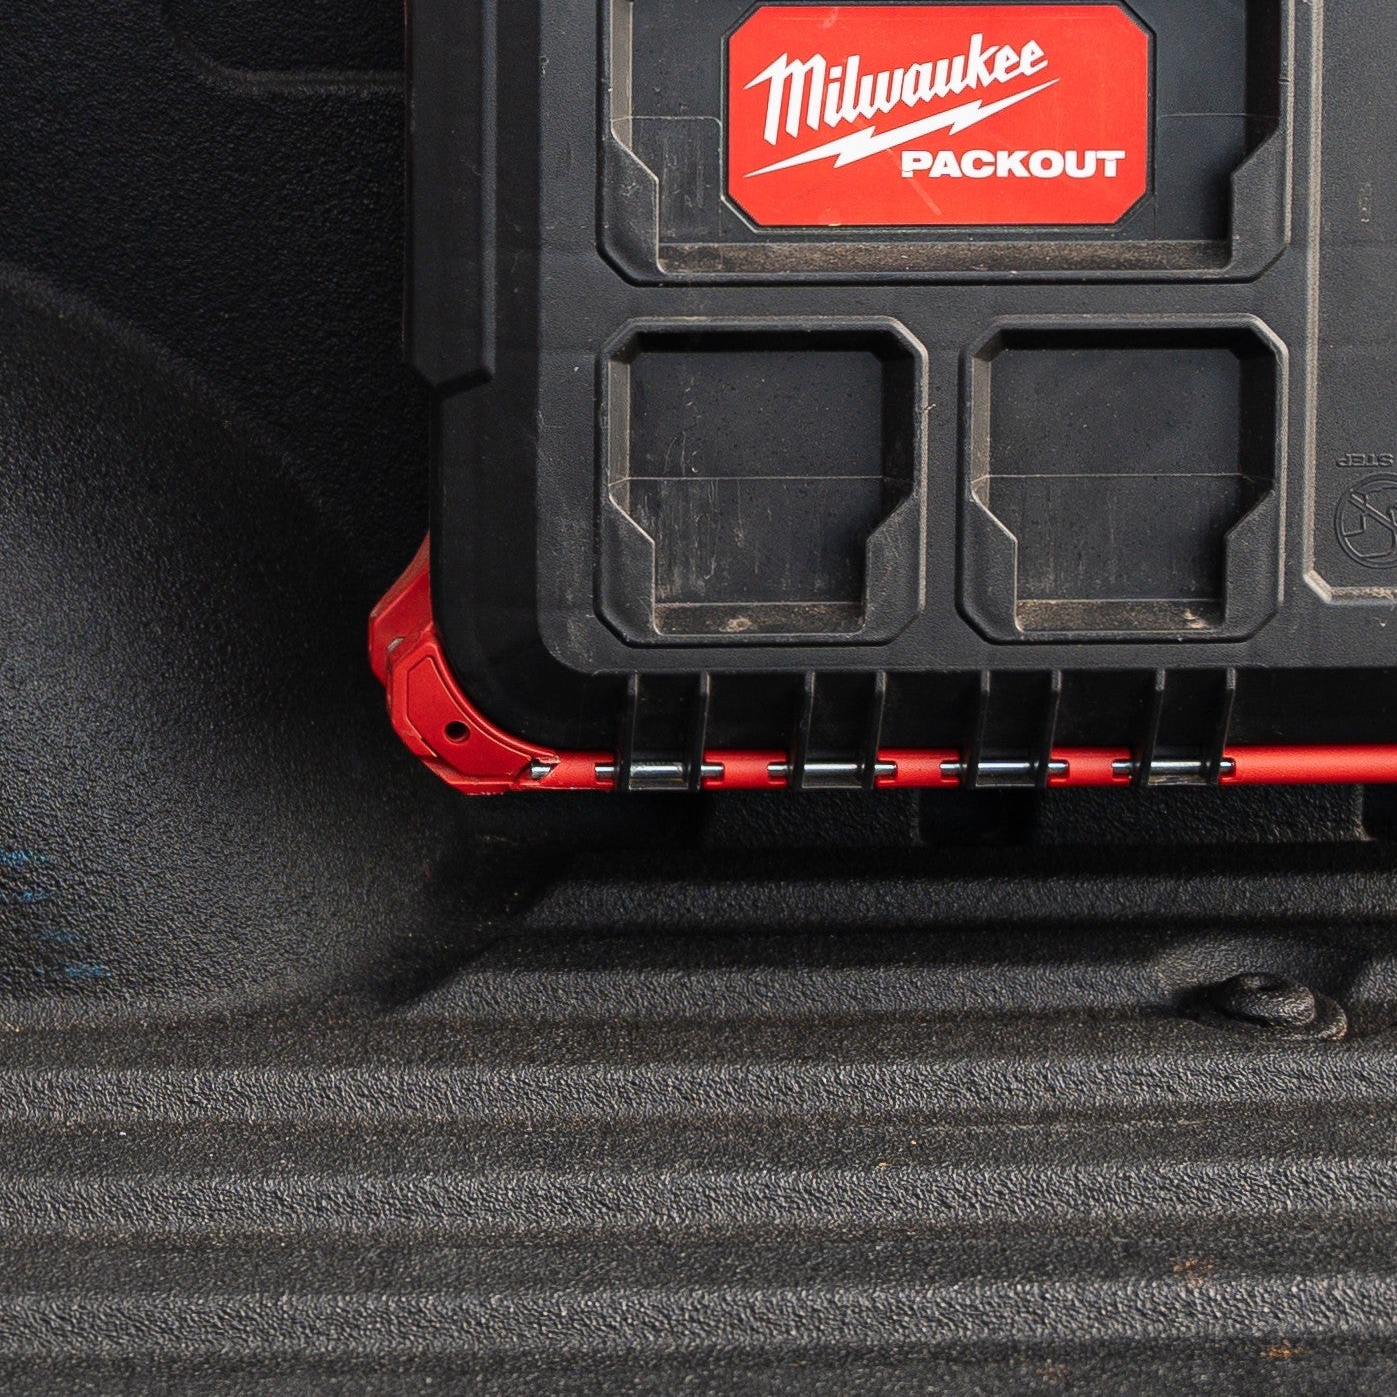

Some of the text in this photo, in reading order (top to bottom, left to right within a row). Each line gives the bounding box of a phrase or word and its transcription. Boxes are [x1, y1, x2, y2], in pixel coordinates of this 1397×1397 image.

[743, 33, 1049, 146] Milwaukee
[901, 149, 1125, 178] PACKOUT
[1335, 453, 1393, 468] STEP
